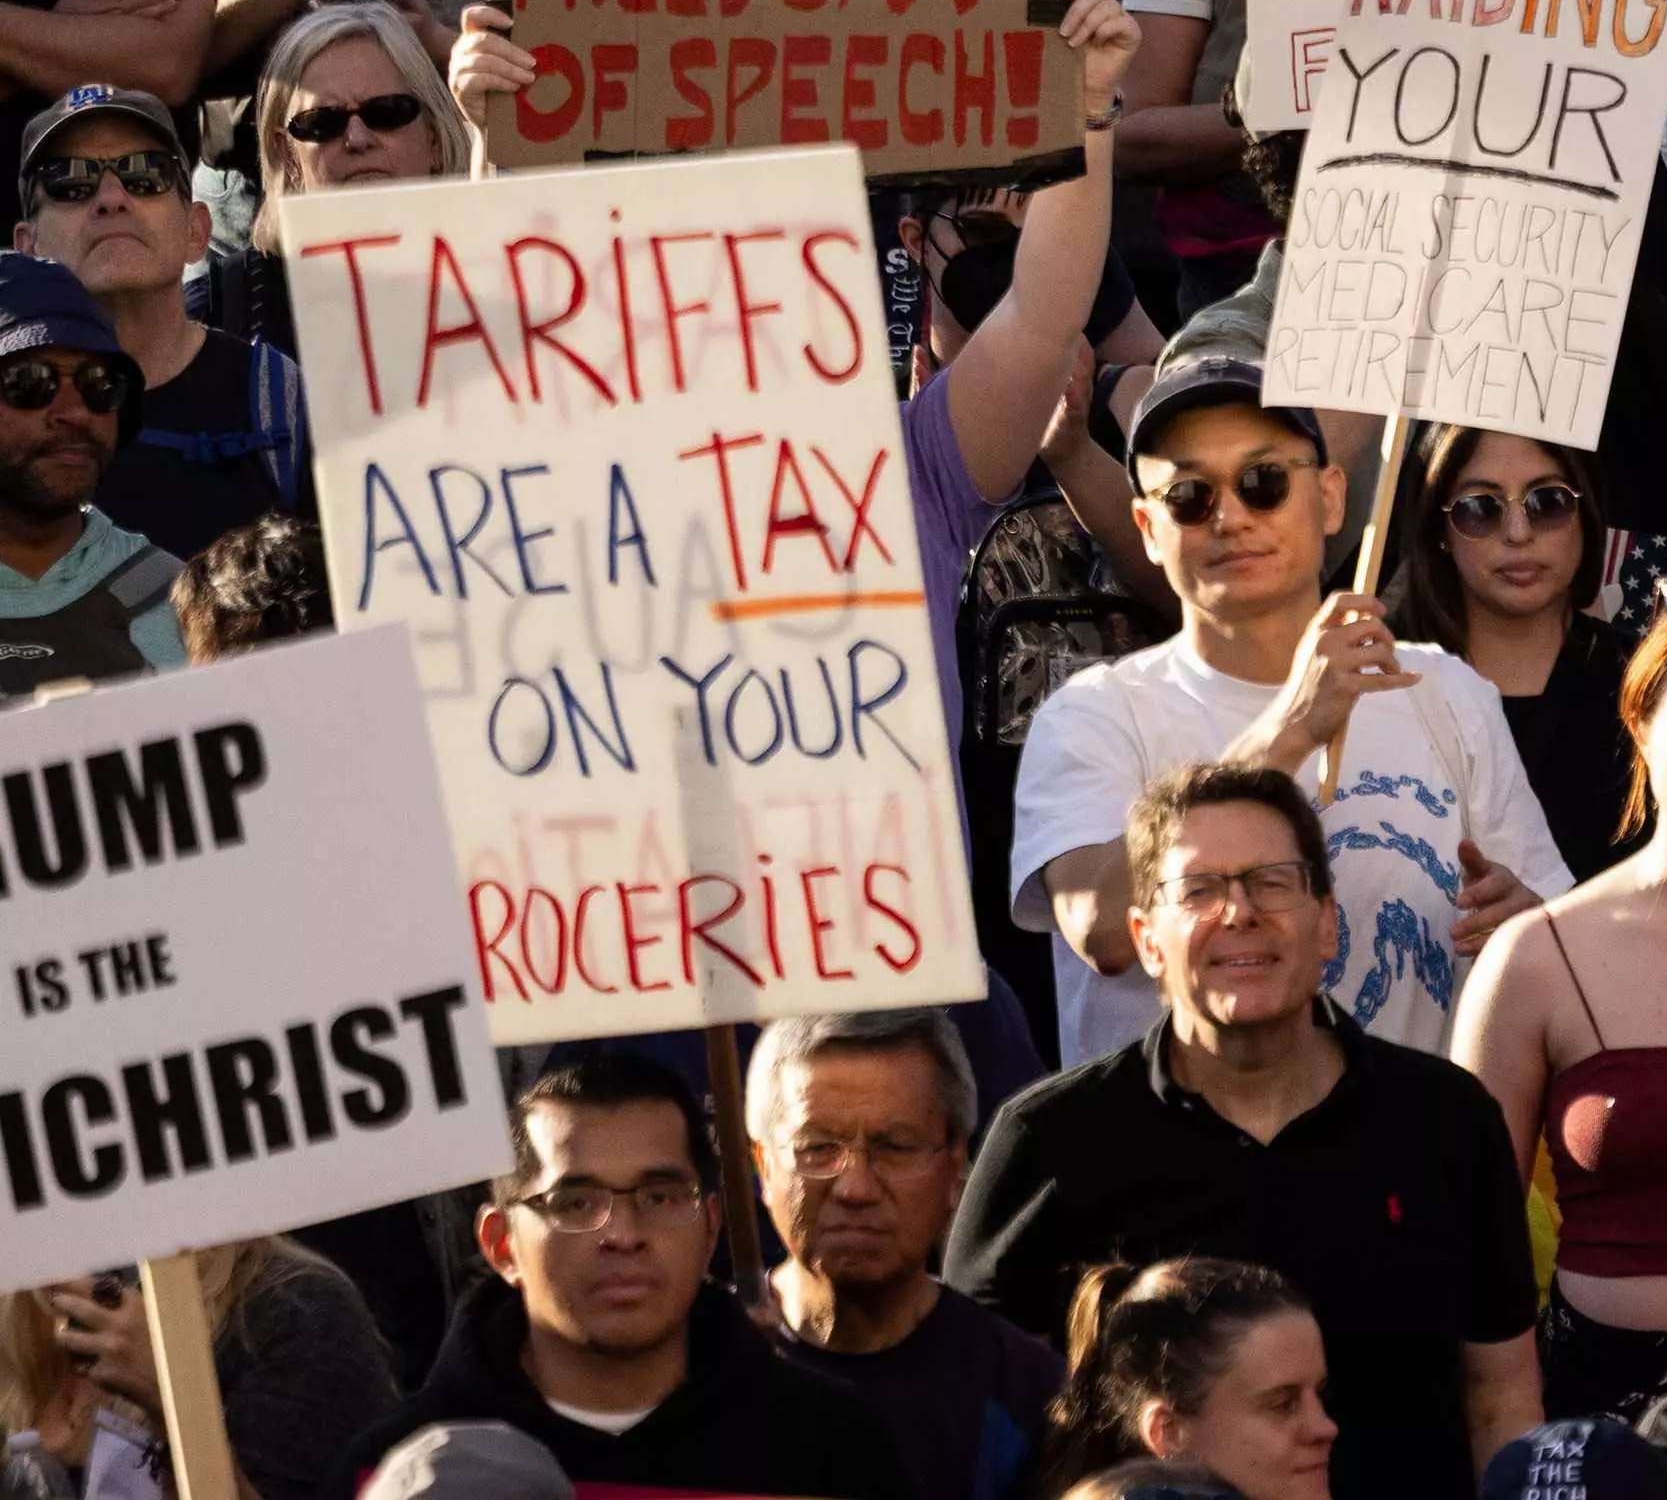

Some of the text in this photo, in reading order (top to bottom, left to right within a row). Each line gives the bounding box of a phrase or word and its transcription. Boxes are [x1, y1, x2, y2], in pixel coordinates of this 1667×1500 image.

[513, 29, 1045, 150] OF SPEECH!
[1338, 47, 1628, 184] YOUR
[1291, 186, 1633, 283] SOCIAL SECURITY
[302, 208, 864, 416] TARIFFS
[1284, 259, 1620, 356] MEDICARE
[1269, 326, 1608, 433] RETIREMENT
[359, 431, 893, 612] ARE A TAX
[488, 641, 923, 778] ON YOUR
[0, 718, 268, 898] UMP
[15, 933, 177, 1019] IS THE
[469, 854, 923, 1004] ROCERIES
[0, 984, 468, 1214] ICHRIST
[1528, 1459, 1585, 1485] THE
[1531, 1441, 1585, 1462] TAX
